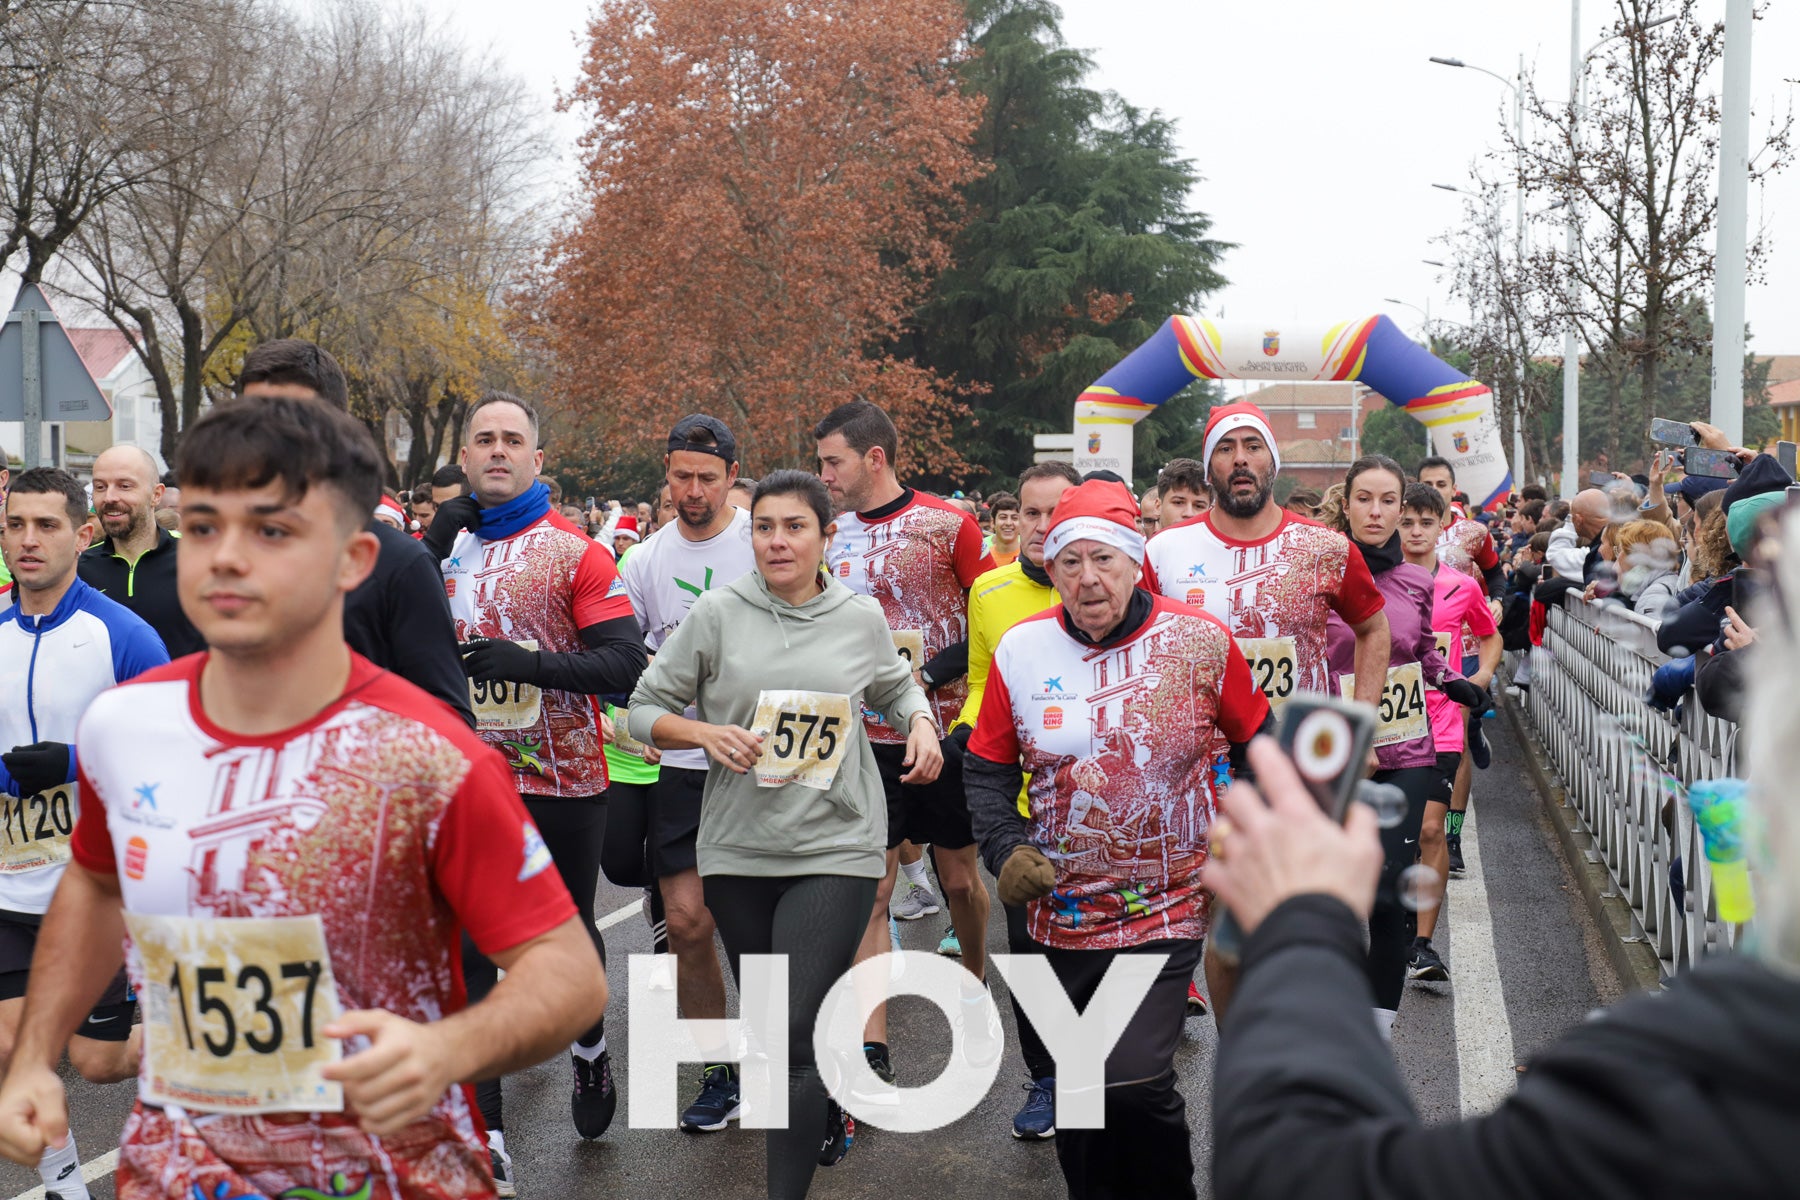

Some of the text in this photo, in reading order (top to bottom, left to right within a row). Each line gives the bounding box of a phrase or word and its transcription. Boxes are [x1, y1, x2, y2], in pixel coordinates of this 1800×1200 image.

[1246, 657, 1294, 697] 23
[774, 712, 840, 760] 575
[4, 790, 73, 845] 1120
[170, 960, 322, 1058] 1537
